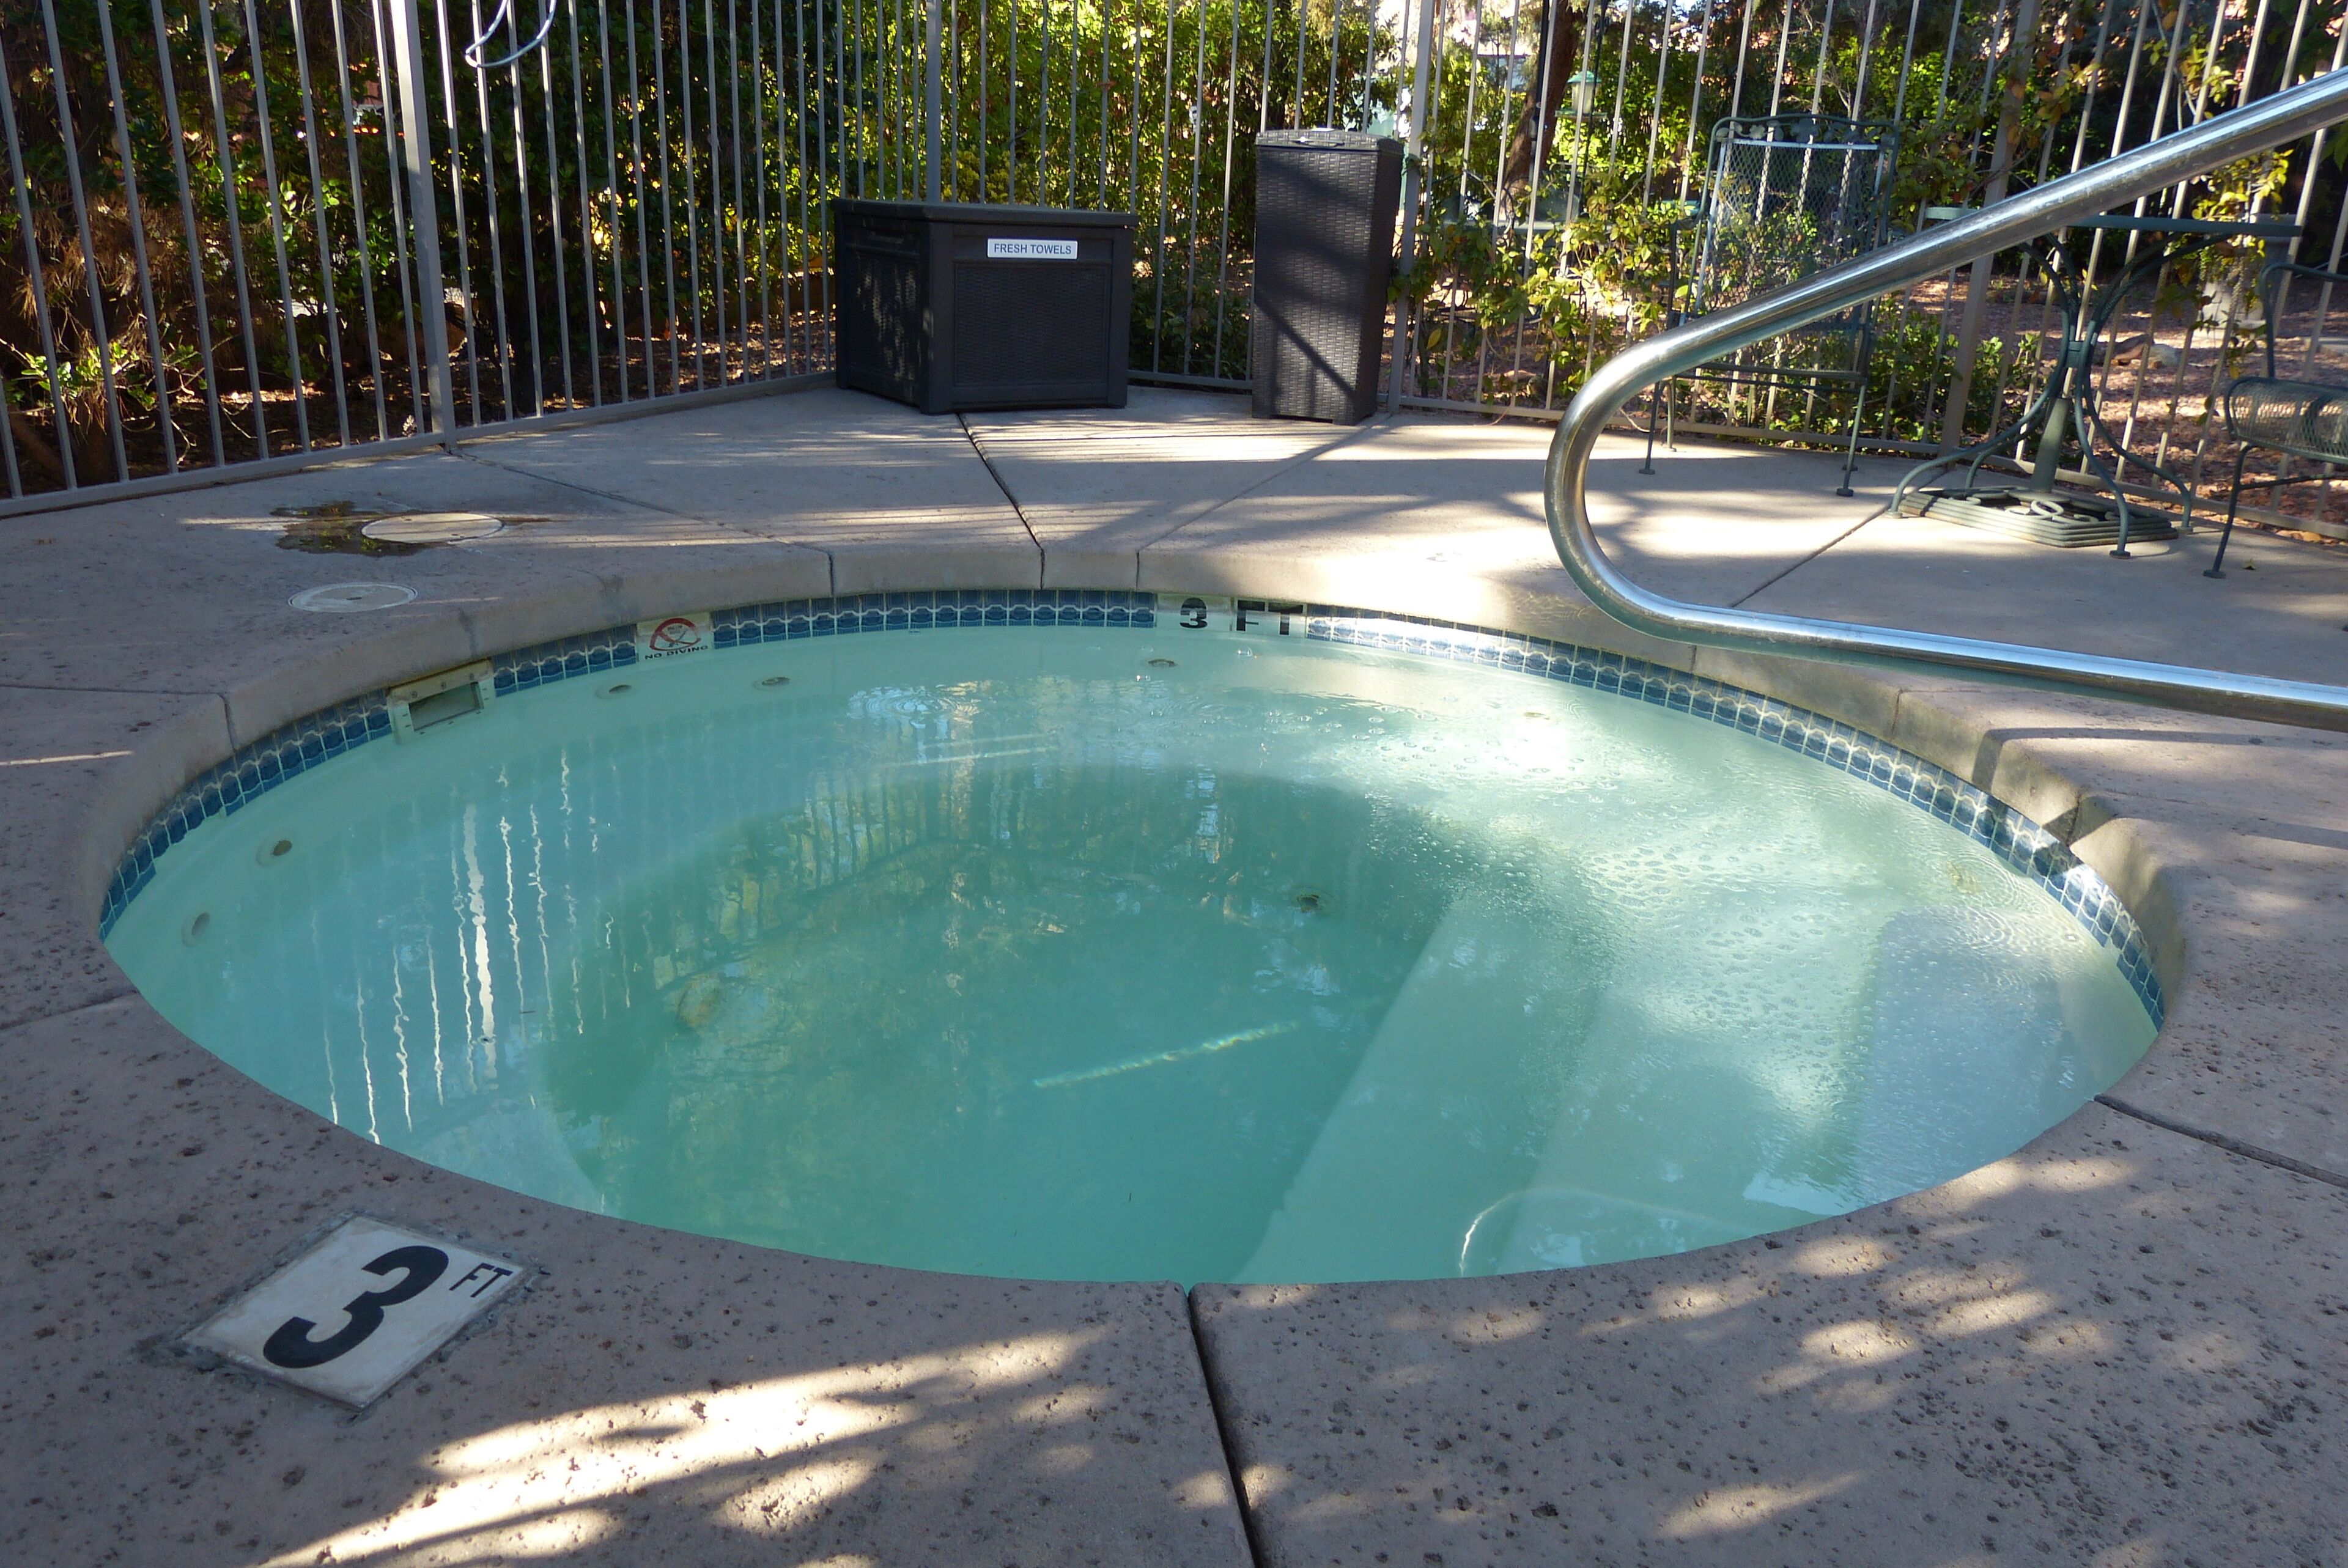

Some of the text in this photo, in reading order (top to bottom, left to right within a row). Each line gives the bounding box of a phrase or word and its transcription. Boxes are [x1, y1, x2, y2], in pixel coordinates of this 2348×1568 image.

[994, 243, 1072, 255] FRESH TOWELS
[1180, 597, 1304, 636] 3 FT
[666, 645, 709, 657] DIVING
[263, 1245, 514, 1369] 3 FT
